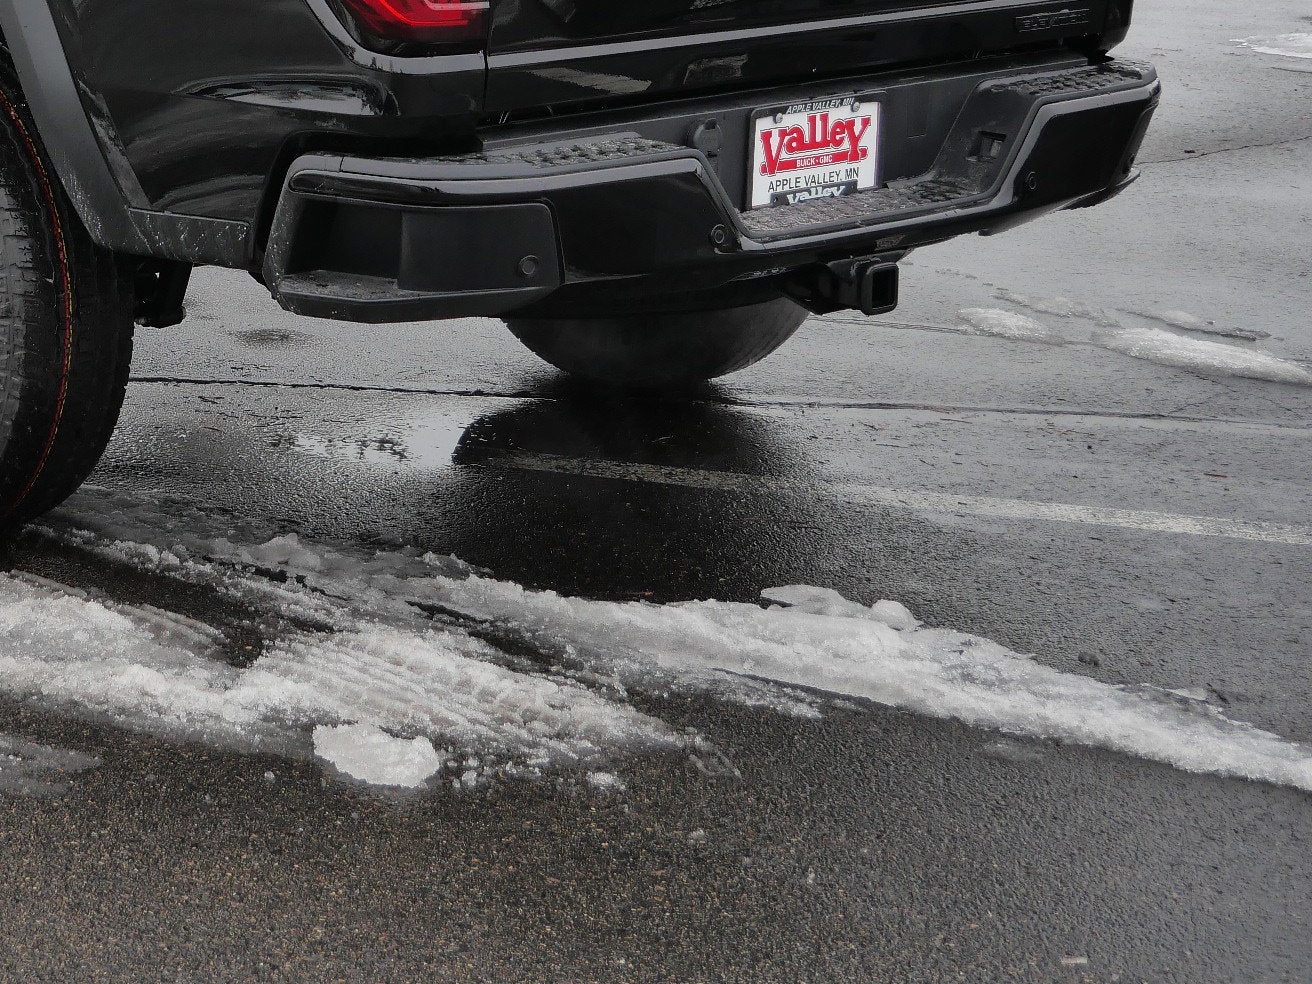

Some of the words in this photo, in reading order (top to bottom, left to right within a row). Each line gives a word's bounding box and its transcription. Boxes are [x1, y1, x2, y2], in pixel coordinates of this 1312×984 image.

[786, 101, 812, 115] APPLE
[842, 98, 855, 106] MN
[760, 111, 871, 176] Valley
[796, 158, 815, 168] BUICK
[819, 154, 833, 164] GMC
[768, 177, 801, 193] APPLE
[845, 167, 859, 179] MN
[787, 185, 846, 204] Valley
